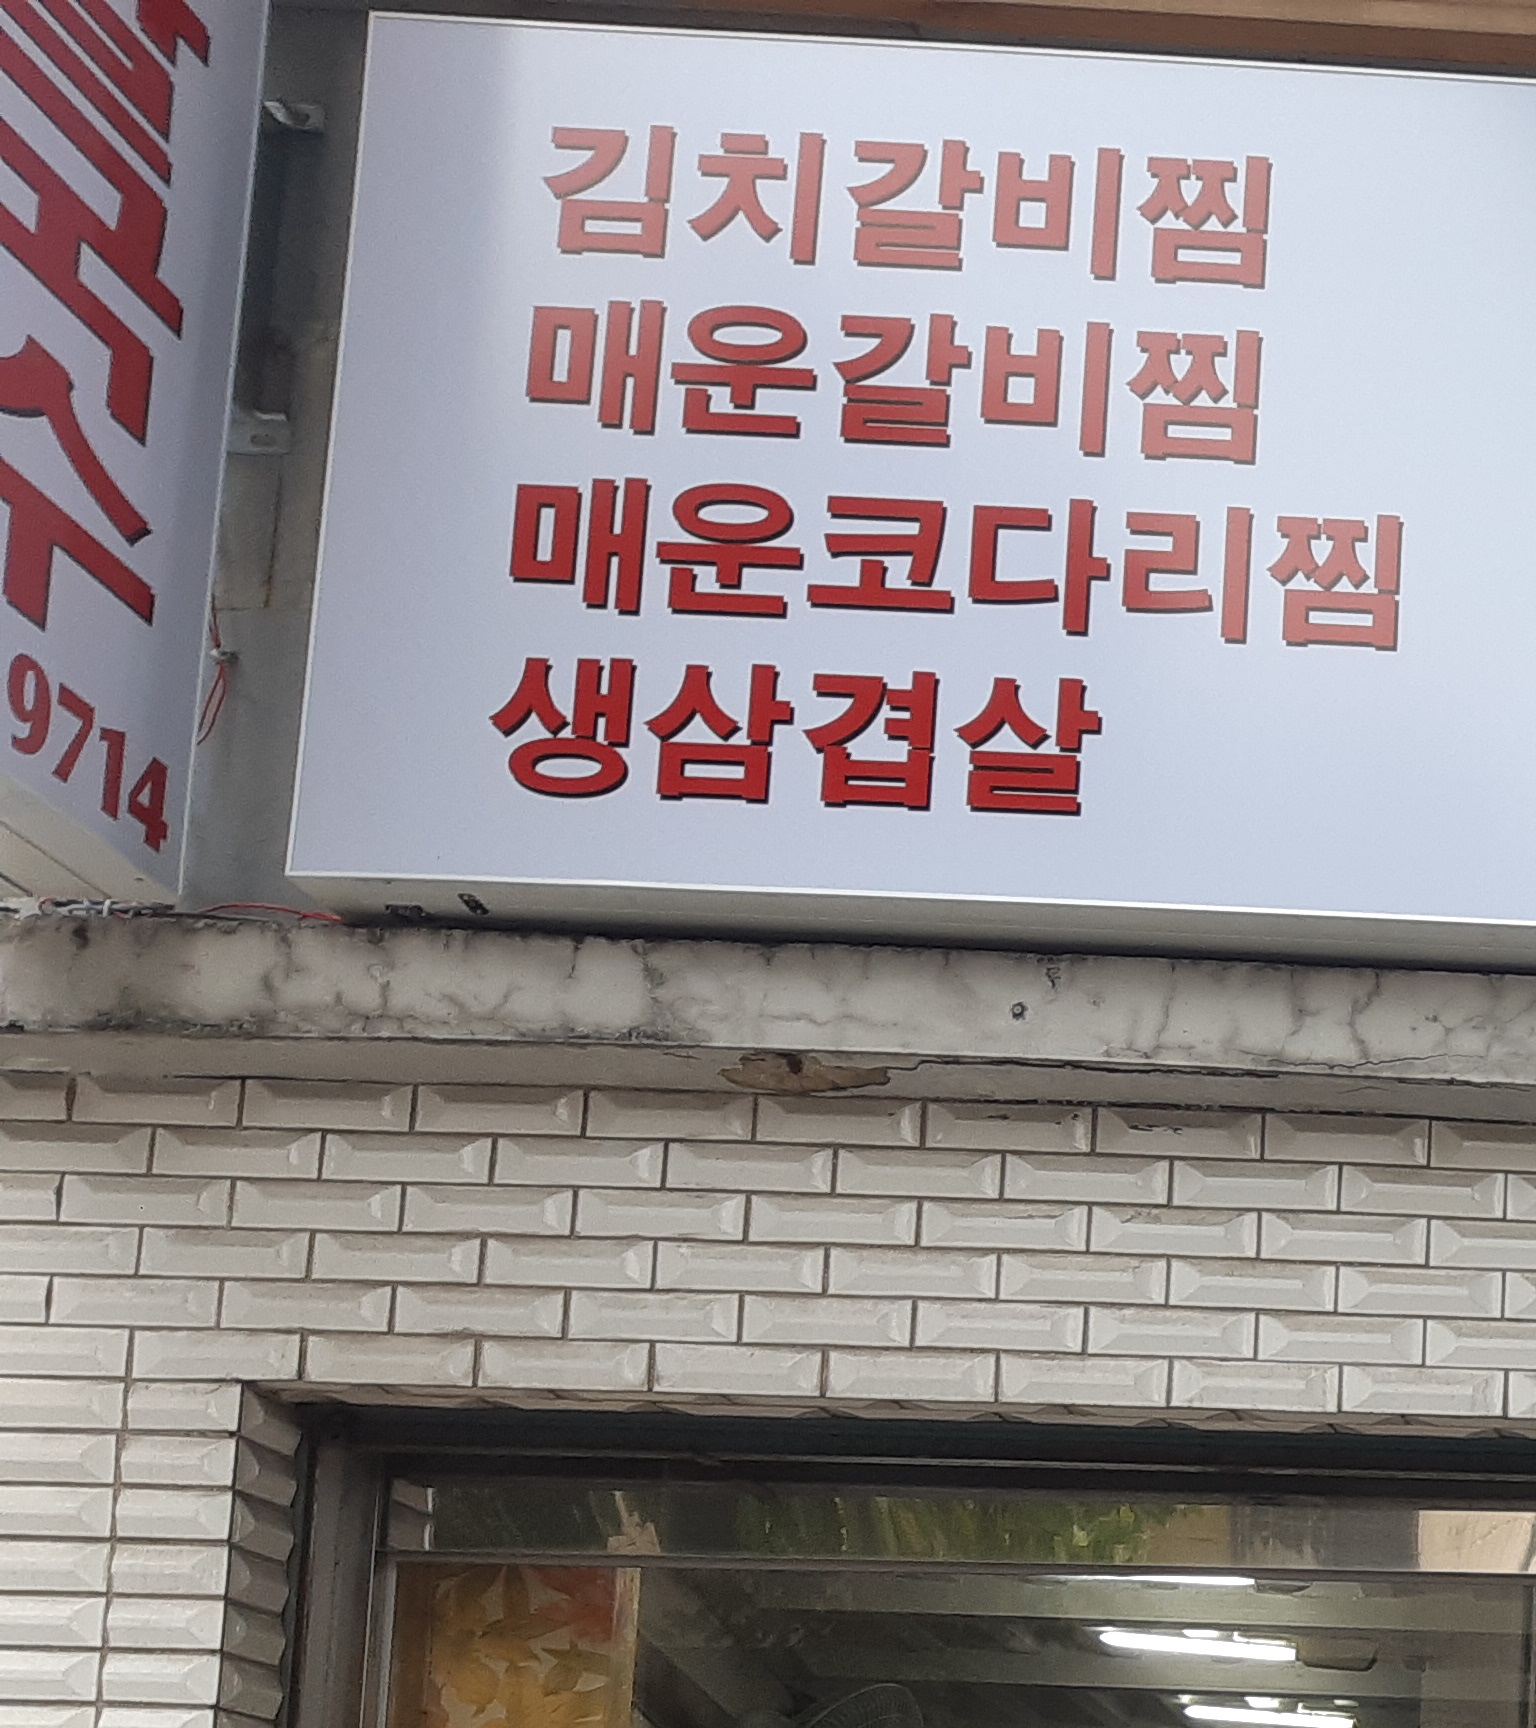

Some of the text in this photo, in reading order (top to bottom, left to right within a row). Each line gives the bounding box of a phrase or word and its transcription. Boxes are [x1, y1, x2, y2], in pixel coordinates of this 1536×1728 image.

[544, 123, 1274, 290] 김치갈비찜
[524, 299, 1264, 465] 매운갈비찜
[508, 478, 1404, 650] 매운코다리찜
[490, 657, 1103, 816] 생삼겹살
